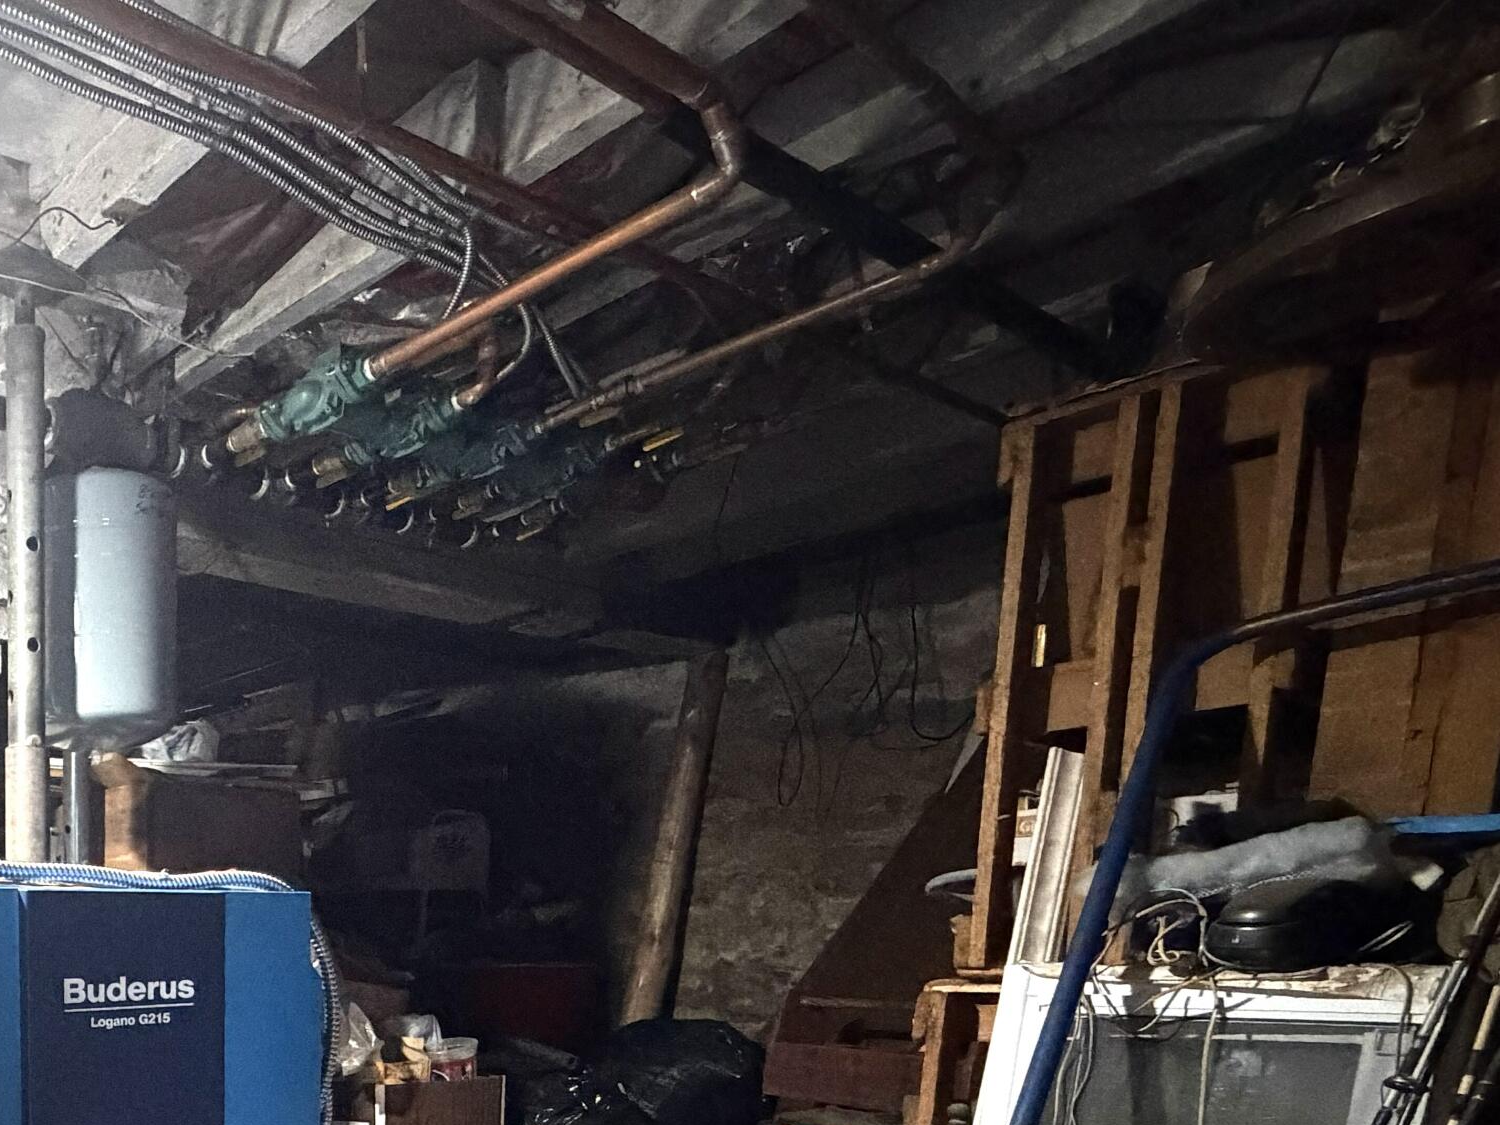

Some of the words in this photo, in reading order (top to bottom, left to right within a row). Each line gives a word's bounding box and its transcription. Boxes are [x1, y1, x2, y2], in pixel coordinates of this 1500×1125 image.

[63, 975, 195, 1004] Buderus
[90, 1016, 136, 1030] Logano
[138, 1012, 171, 1025] G215
